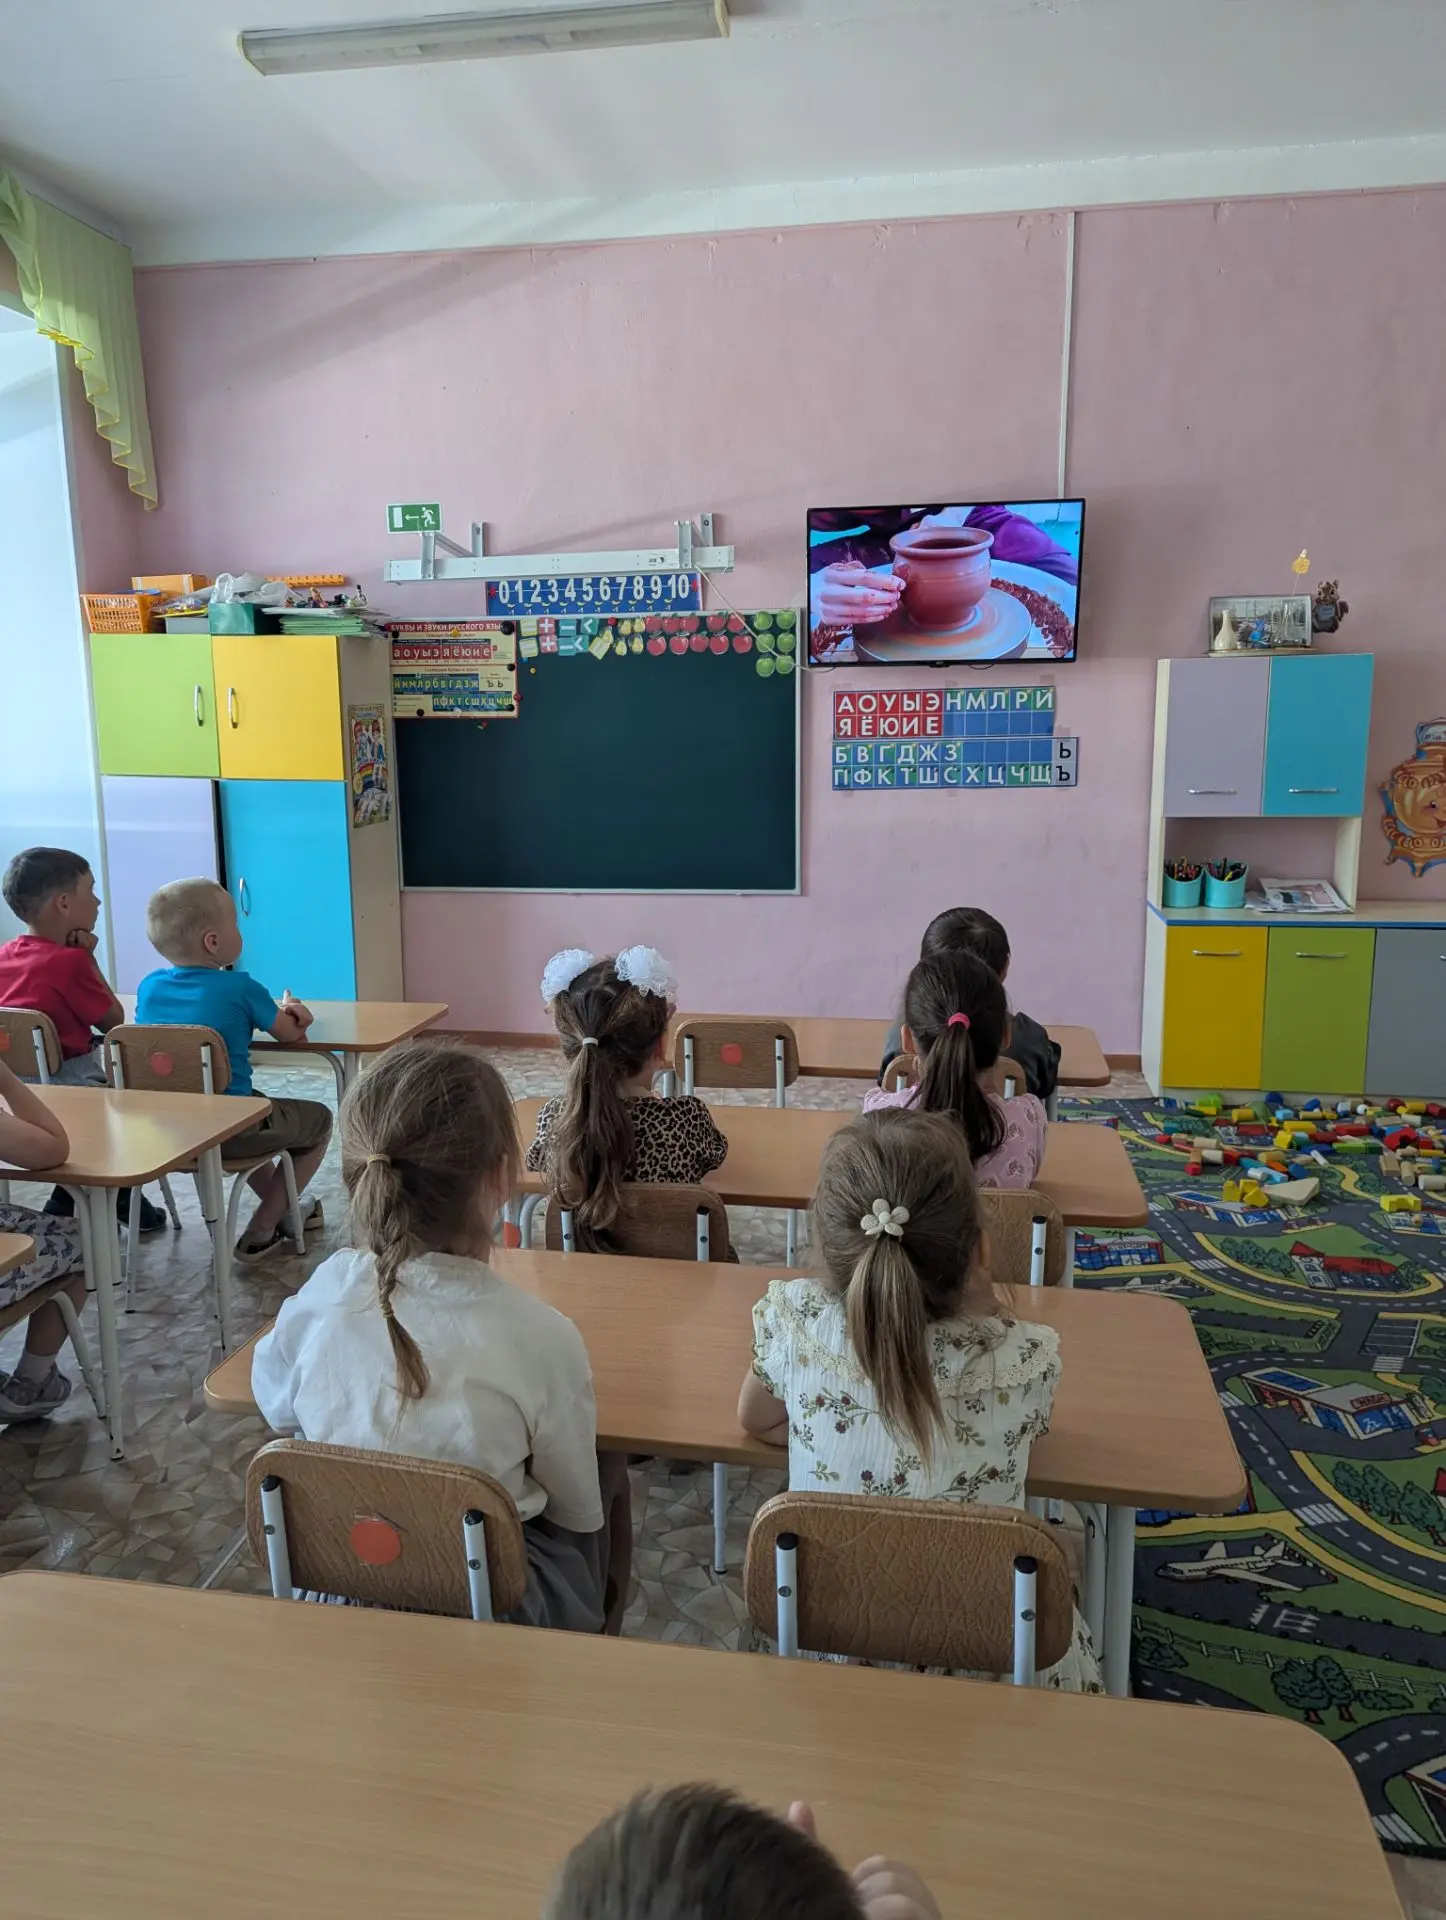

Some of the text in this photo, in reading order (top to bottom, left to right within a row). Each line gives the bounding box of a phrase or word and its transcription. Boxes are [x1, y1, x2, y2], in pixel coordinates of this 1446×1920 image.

[499, 575, 689, 603] 0 1 2 3 4 5 6 7 8 9 10
